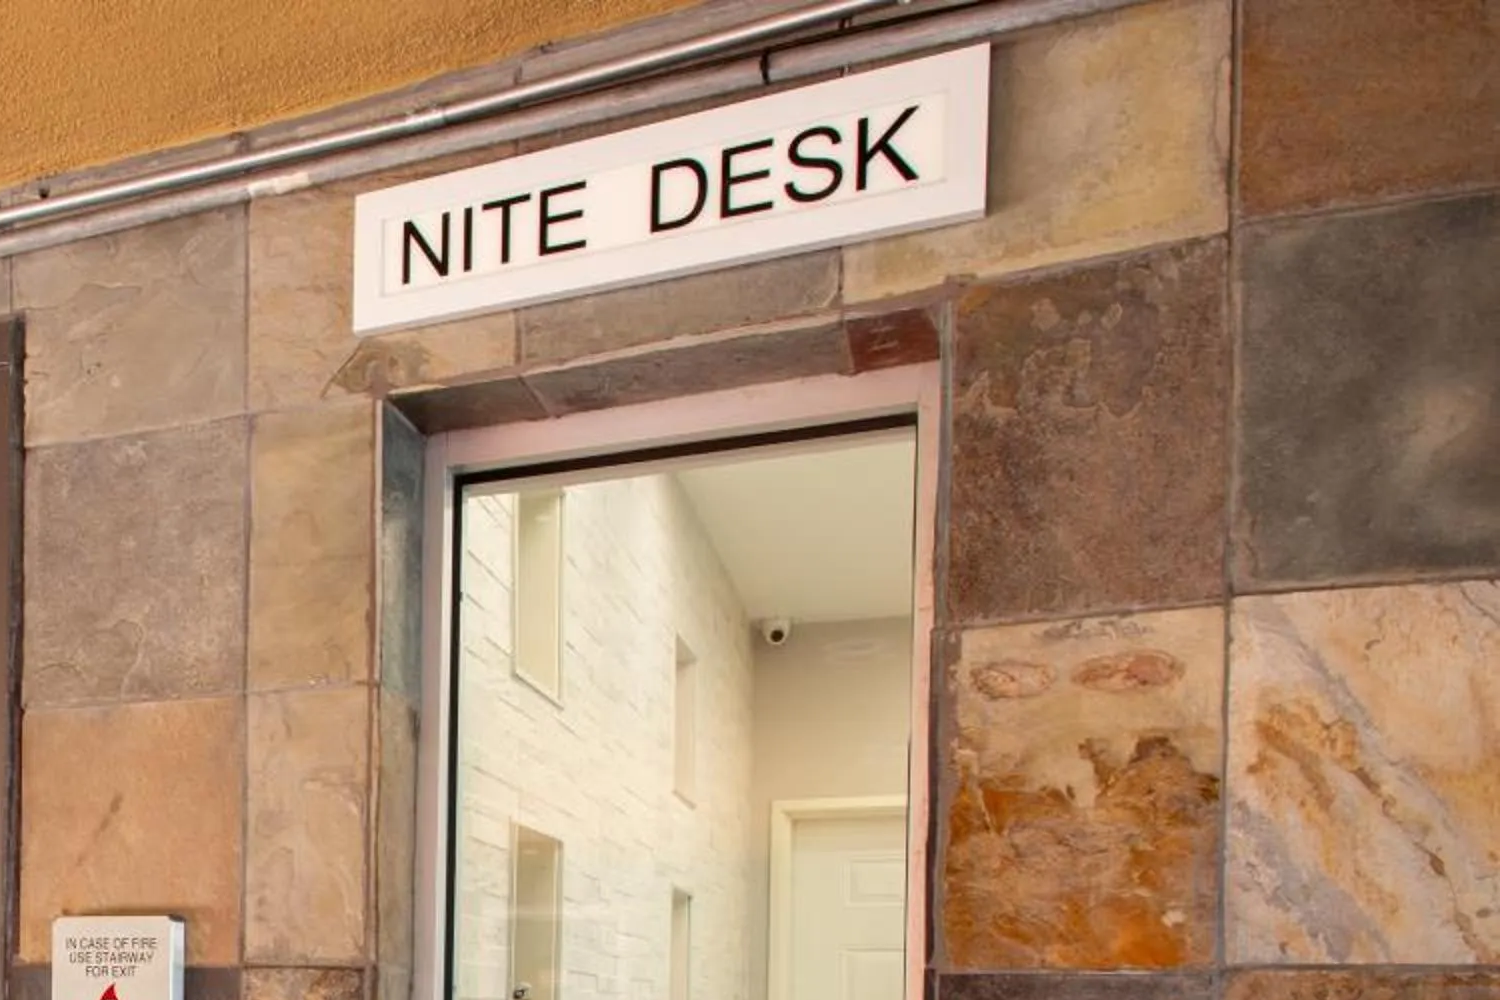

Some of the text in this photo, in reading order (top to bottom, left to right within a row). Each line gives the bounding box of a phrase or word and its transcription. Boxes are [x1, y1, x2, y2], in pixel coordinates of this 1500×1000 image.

[401, 105, 920, 285] NITE DESK
[65, 937, 157, 950] IN CASE OF FIRE
[69, 951, 154, 964] USE STAIRWAY
[85, 965, 137, 977] FOR EXIT
